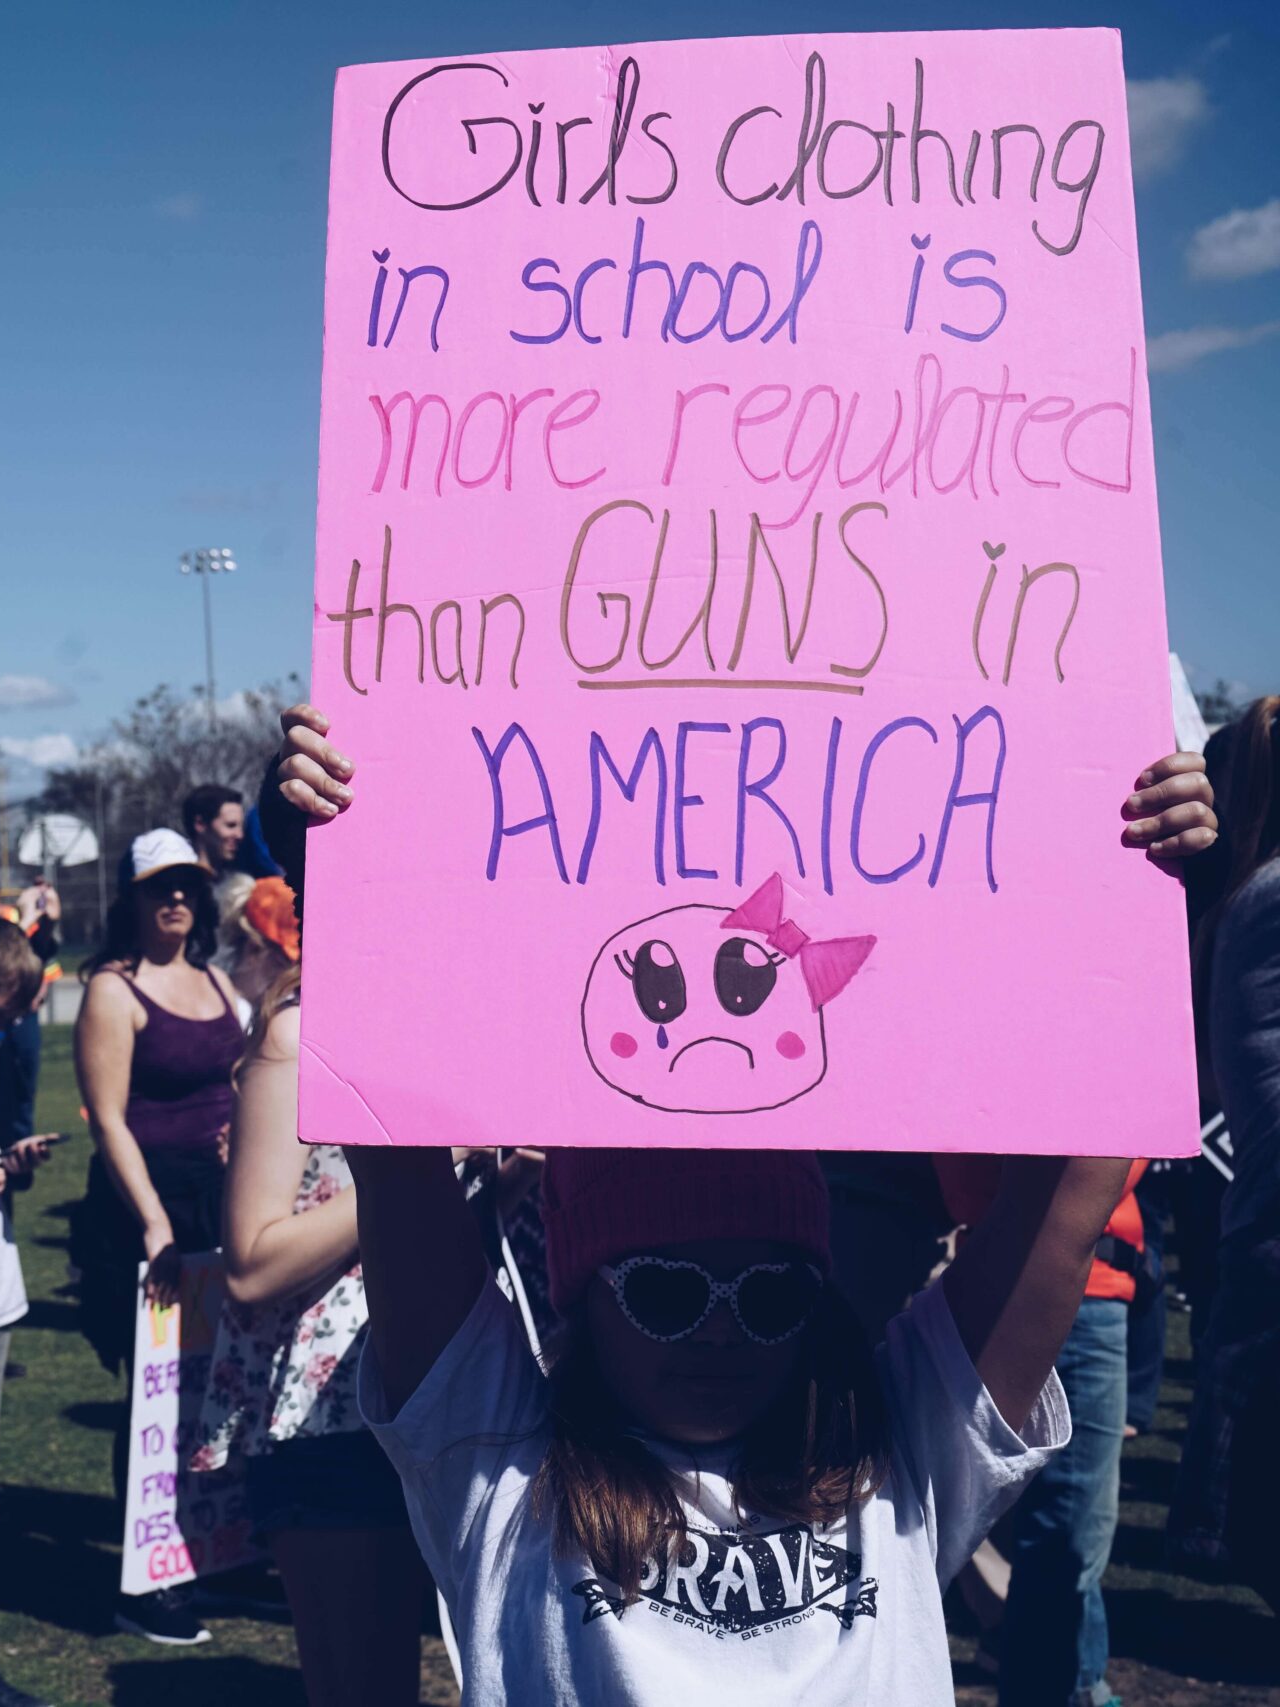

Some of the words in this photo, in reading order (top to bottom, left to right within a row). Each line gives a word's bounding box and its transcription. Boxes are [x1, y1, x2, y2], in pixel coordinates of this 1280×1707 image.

[381, 55, 678, 211] Girls
[715, 50, 1106, 256] clothing
[366, 247, 451, 352] in
[508, 215, 822, 344] school
[904, 232, 1008, 342] is
[368, 386, 608, 495] more
[662, 347, 1137, 530] regulated
[326, 524, 526, 696] than
[559, 499, 890, 678] GUNS
[971, 540, 1081, 686] in
[471, 704, 1009, 896] AMERICA
[648, 1600, 669, 1618] BE
[673, 1611, 728, 1641] BRAVE
[740, 1626, 762, 1642] BE
[764, 1606, 816, 1635] STRONG
